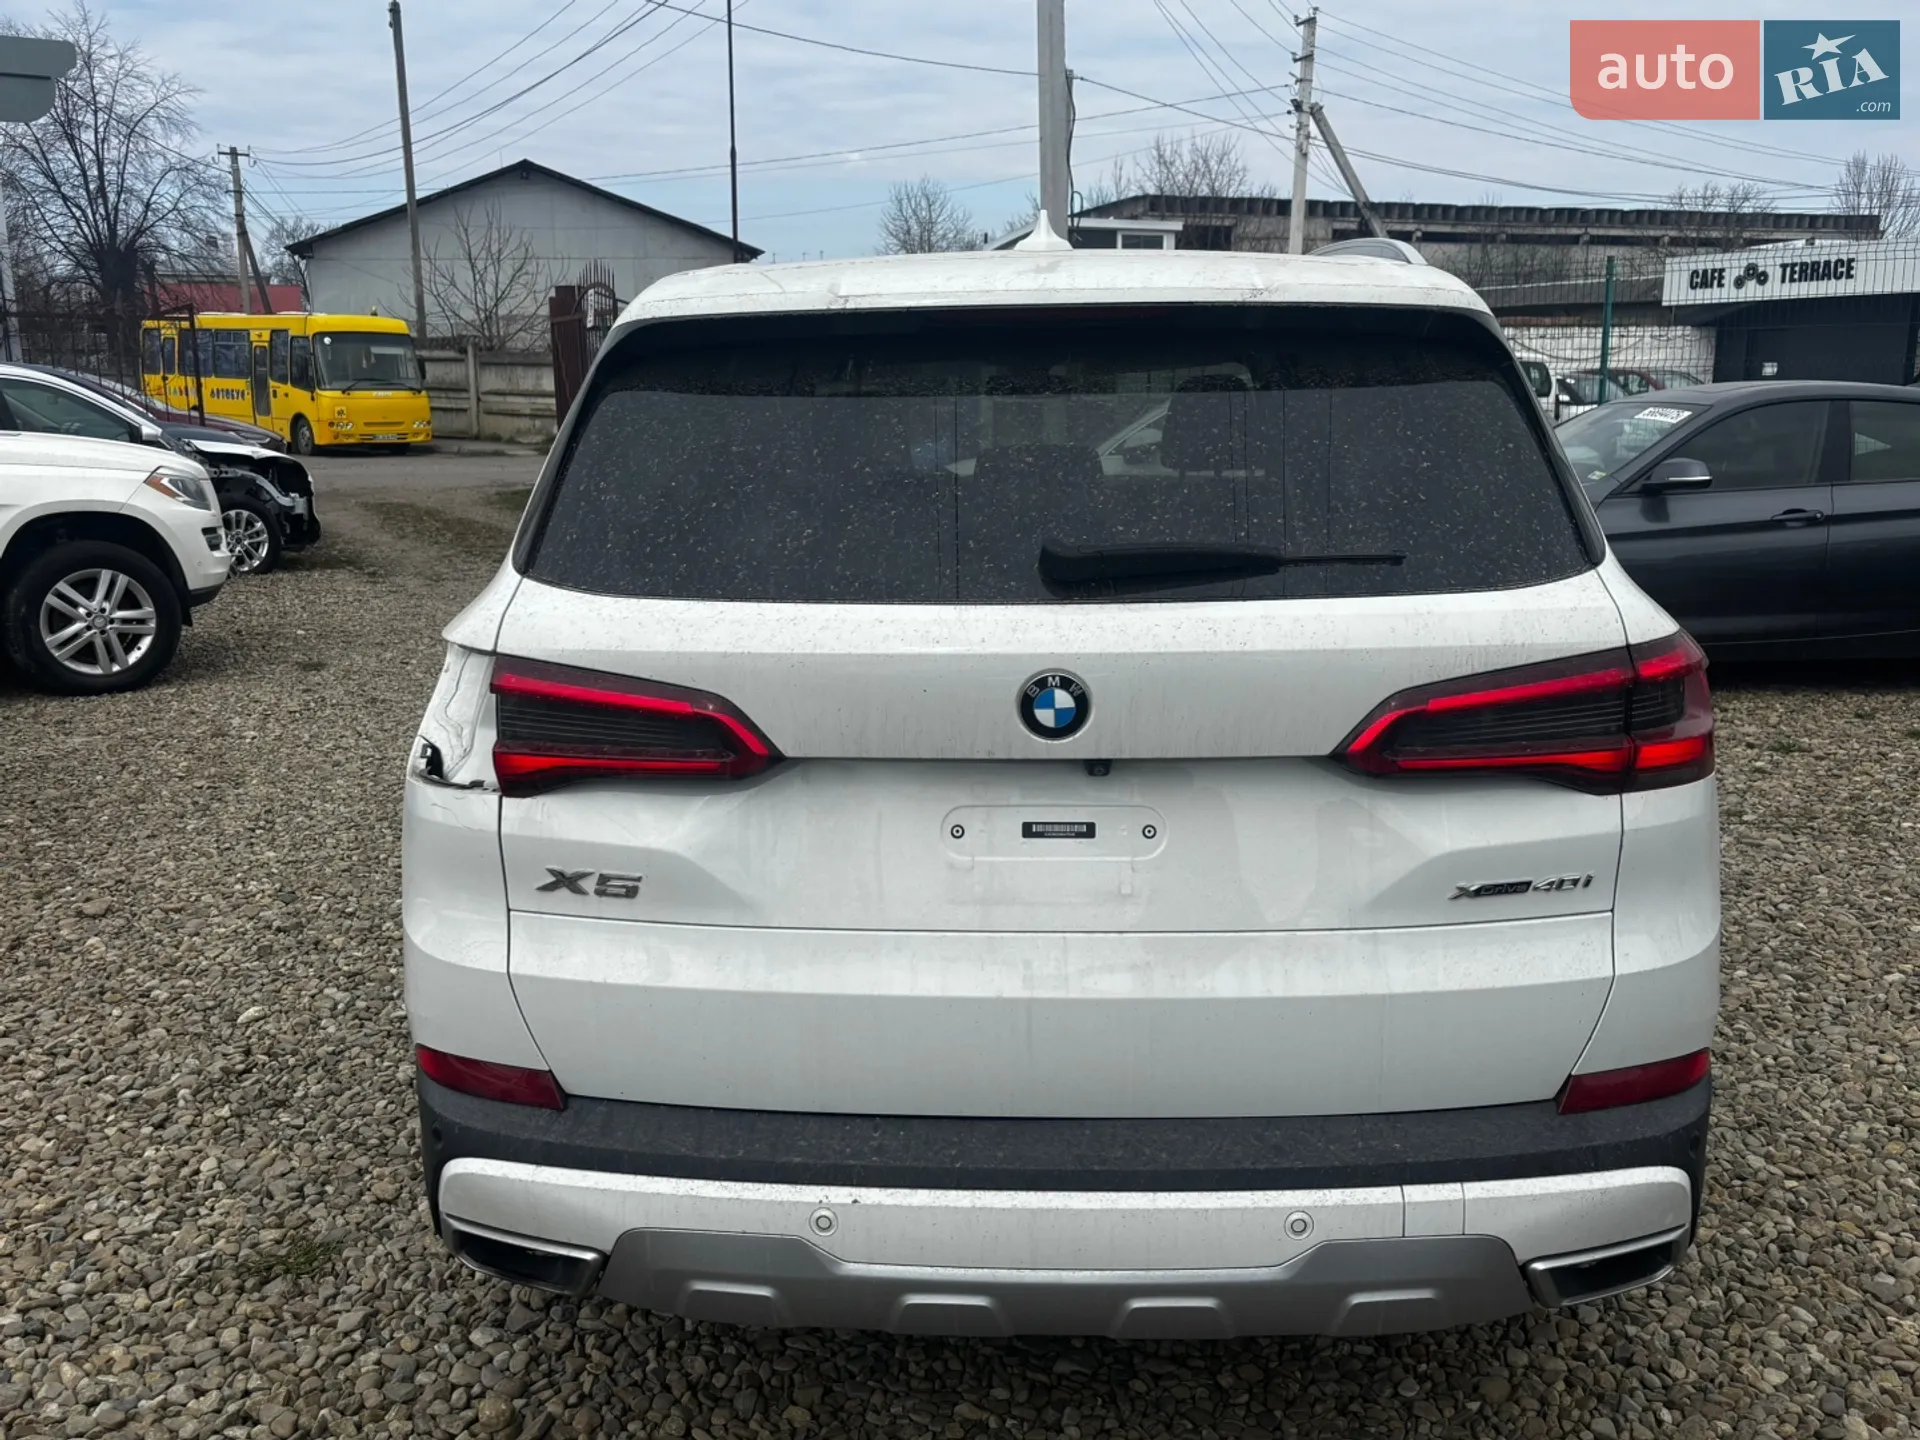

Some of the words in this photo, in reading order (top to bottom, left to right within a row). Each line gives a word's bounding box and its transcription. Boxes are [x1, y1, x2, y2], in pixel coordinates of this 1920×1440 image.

[1689, 267, 1726, 290] CAFE
[1779, 257, 1856, 284] TERRACE
[1026, 675, 1084, 698] BMW
[534, 864, 643, 899] X5
